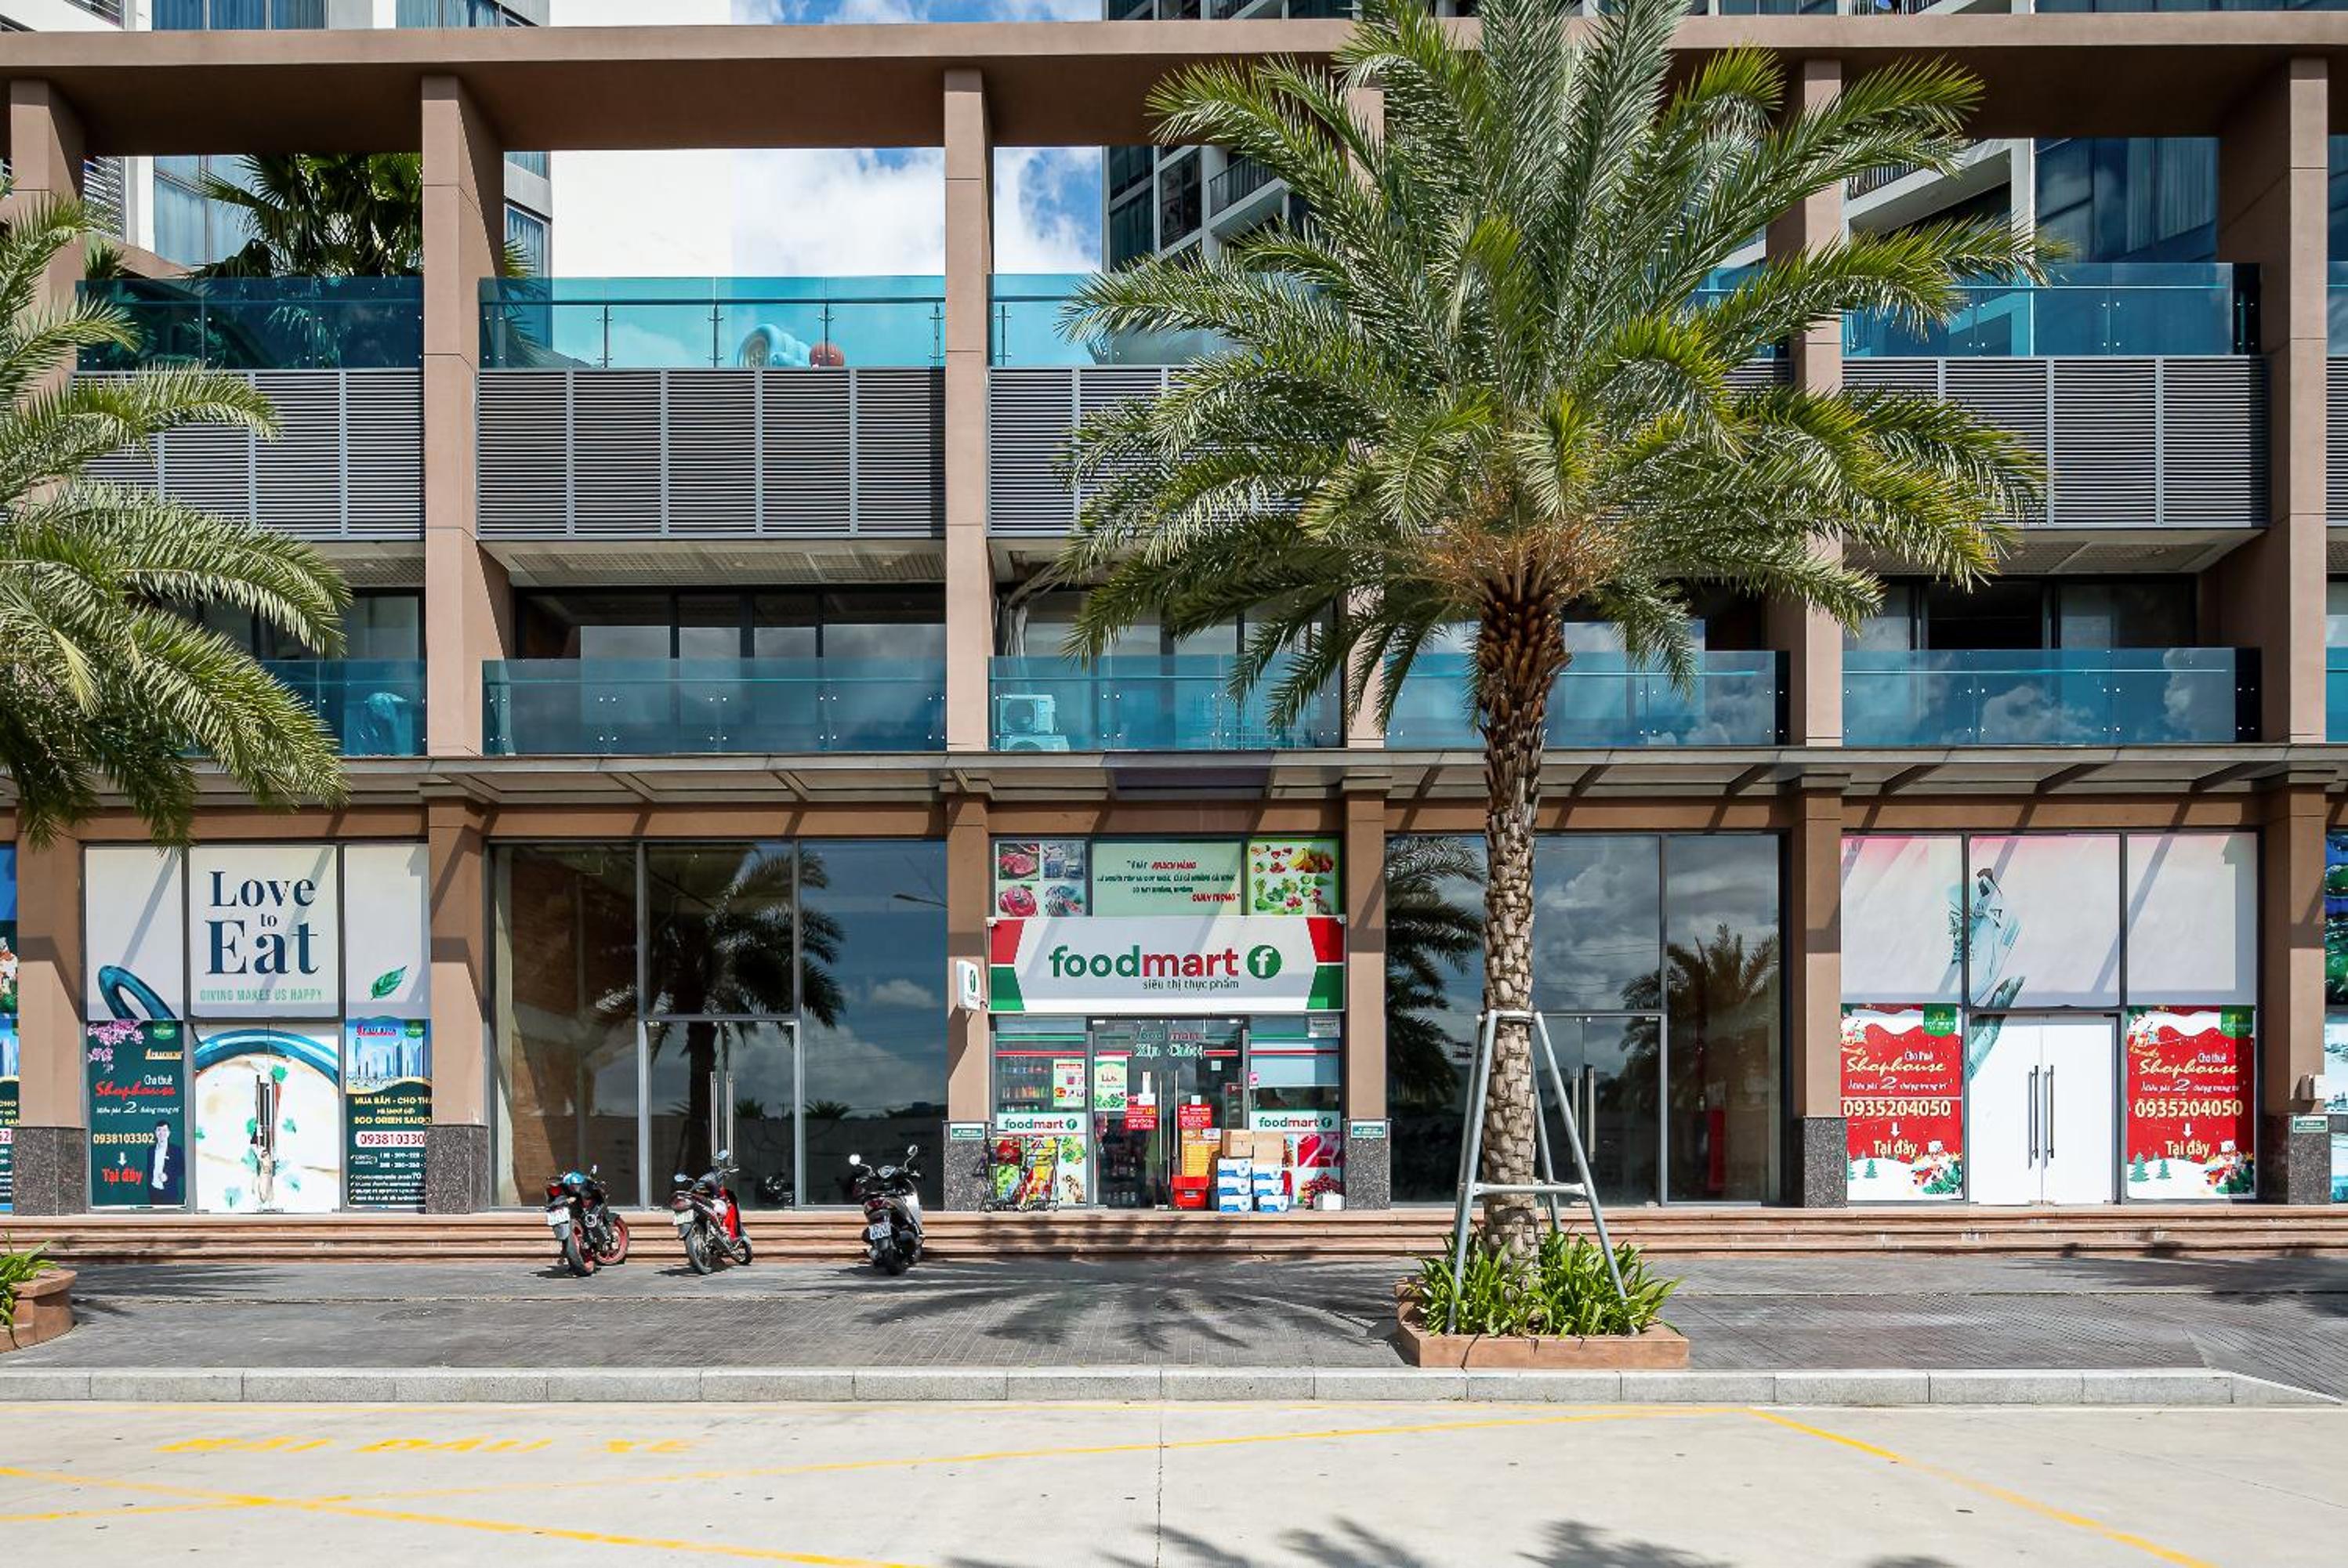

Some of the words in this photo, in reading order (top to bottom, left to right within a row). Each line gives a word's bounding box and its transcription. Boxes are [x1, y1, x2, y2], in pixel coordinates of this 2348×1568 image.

[209, 871, 316, 907] Love
[260, 914, 277, 927] to
[205, 920, 320, 975] Eat
[1049, 945, 1238, 977] foodmart
[1143, 979, 1164, 989] siêu
[1167, 979, 1181, 991] thị
[1184, 979, 1207, 991] thực
[1209, 976, 1239, 991] phẩm
[200, 988, 234, 1001] GIVING
[237, 988, 271, 1001] MAKES
[275, 988, 288, 1001] US
[291, 988, 323, 1001] HAPPY
[1846, 1056, 1946, 1077] Shophouse
[2139, 1059, 2239, 1078] Shophouse
[1880, 1076, 1897, 1089] 2
[2172, 1079, 2190, 1092] 2
[123, 1101, 137, 1113] 2
[1843, 1100, 1951, 1117] 0935204050
[2134, 1100, 2244, 1117] 0935204050
[1005, 1118, 1063, 1128] foodmart
[1259, 1117, 1319, 1128] foodmart
[93, 1132, 155, 1144] 0938103302
[1873, 1140, 1891, 1155] Tại
[1894, 1139, 1918, 1157] đây
[2165, 1140, 2184, 1155] Tại
[2187, 1139, 2210, 1157] đây
[102, 1167, 119, 1186] Tại
